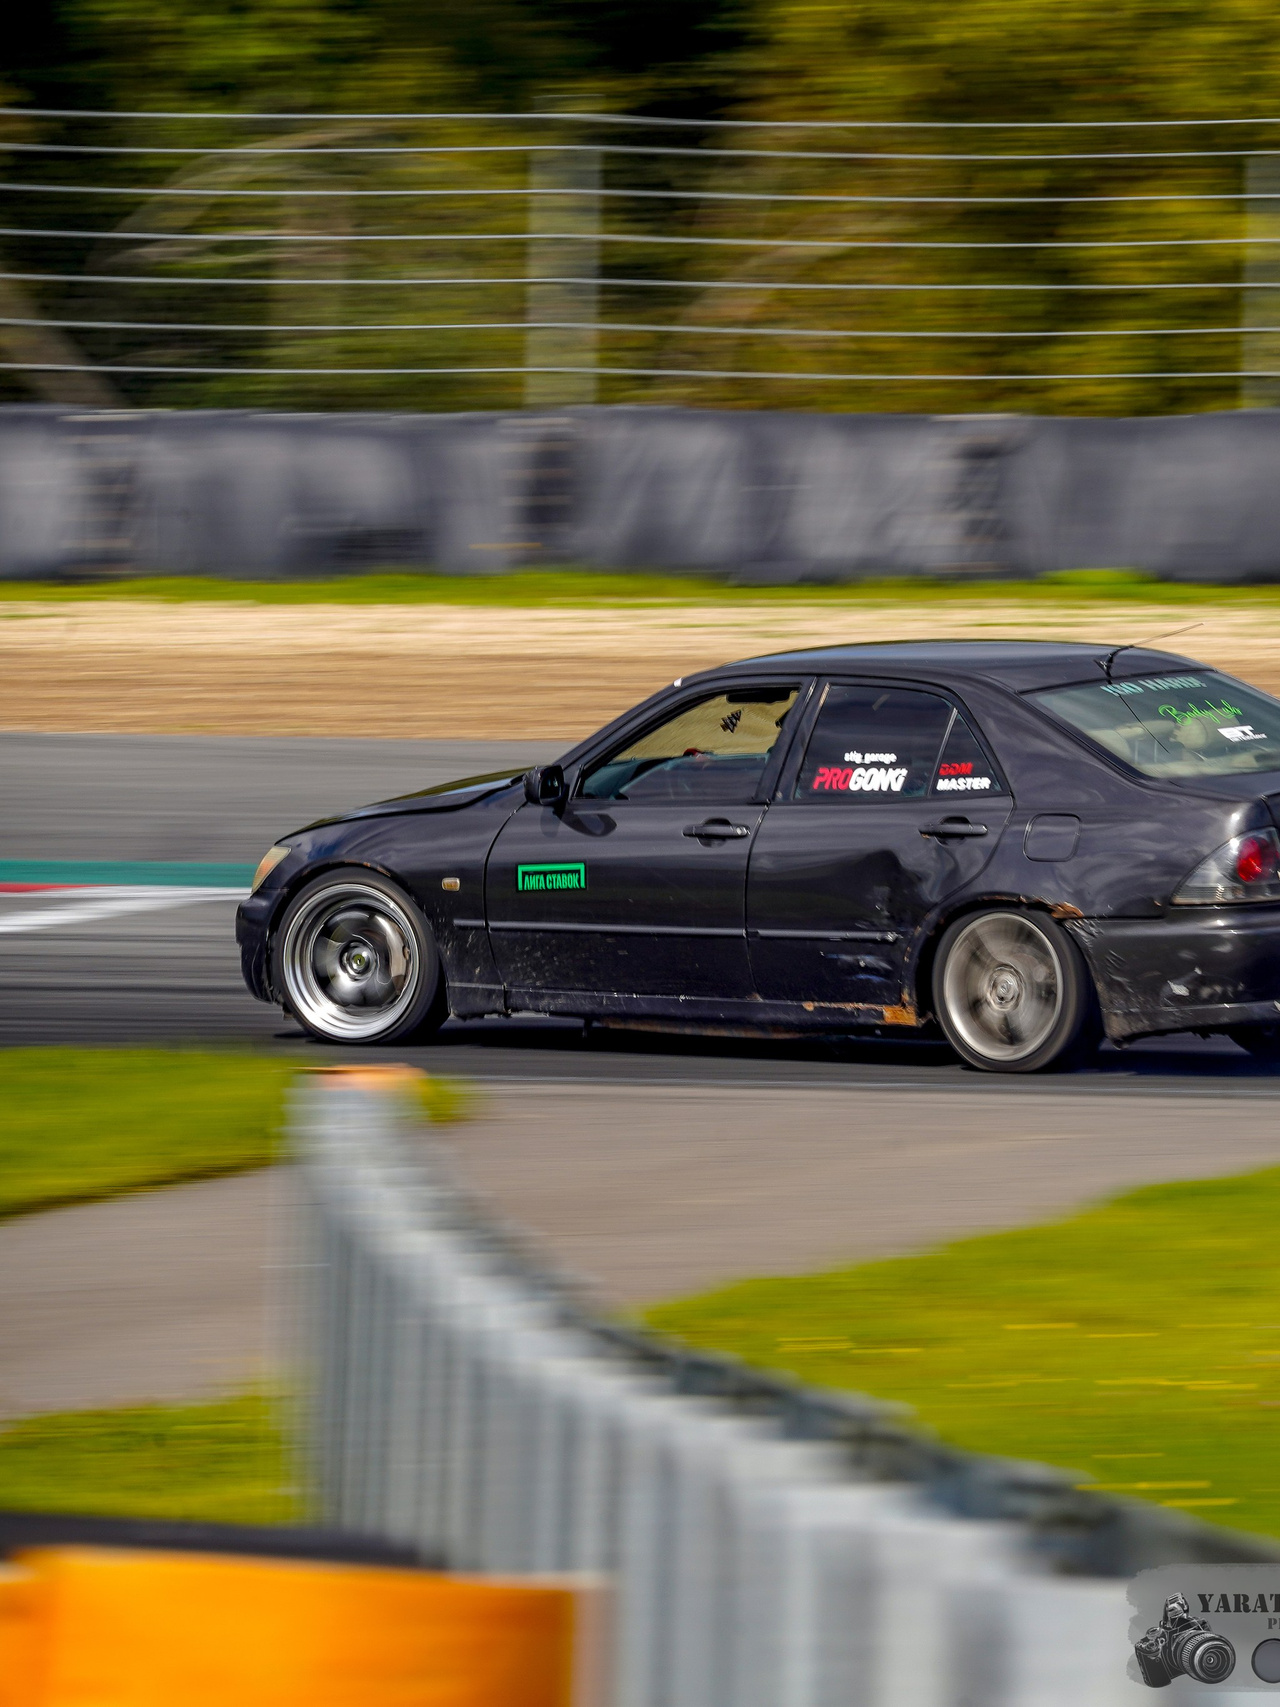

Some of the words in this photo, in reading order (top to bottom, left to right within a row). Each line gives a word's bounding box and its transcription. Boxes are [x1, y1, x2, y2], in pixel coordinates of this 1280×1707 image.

[936, 777, 992, 791] MASTER
[524, 874, 546, 891] ЛИГА
[546, 872, 580, 889] СТАВОК
